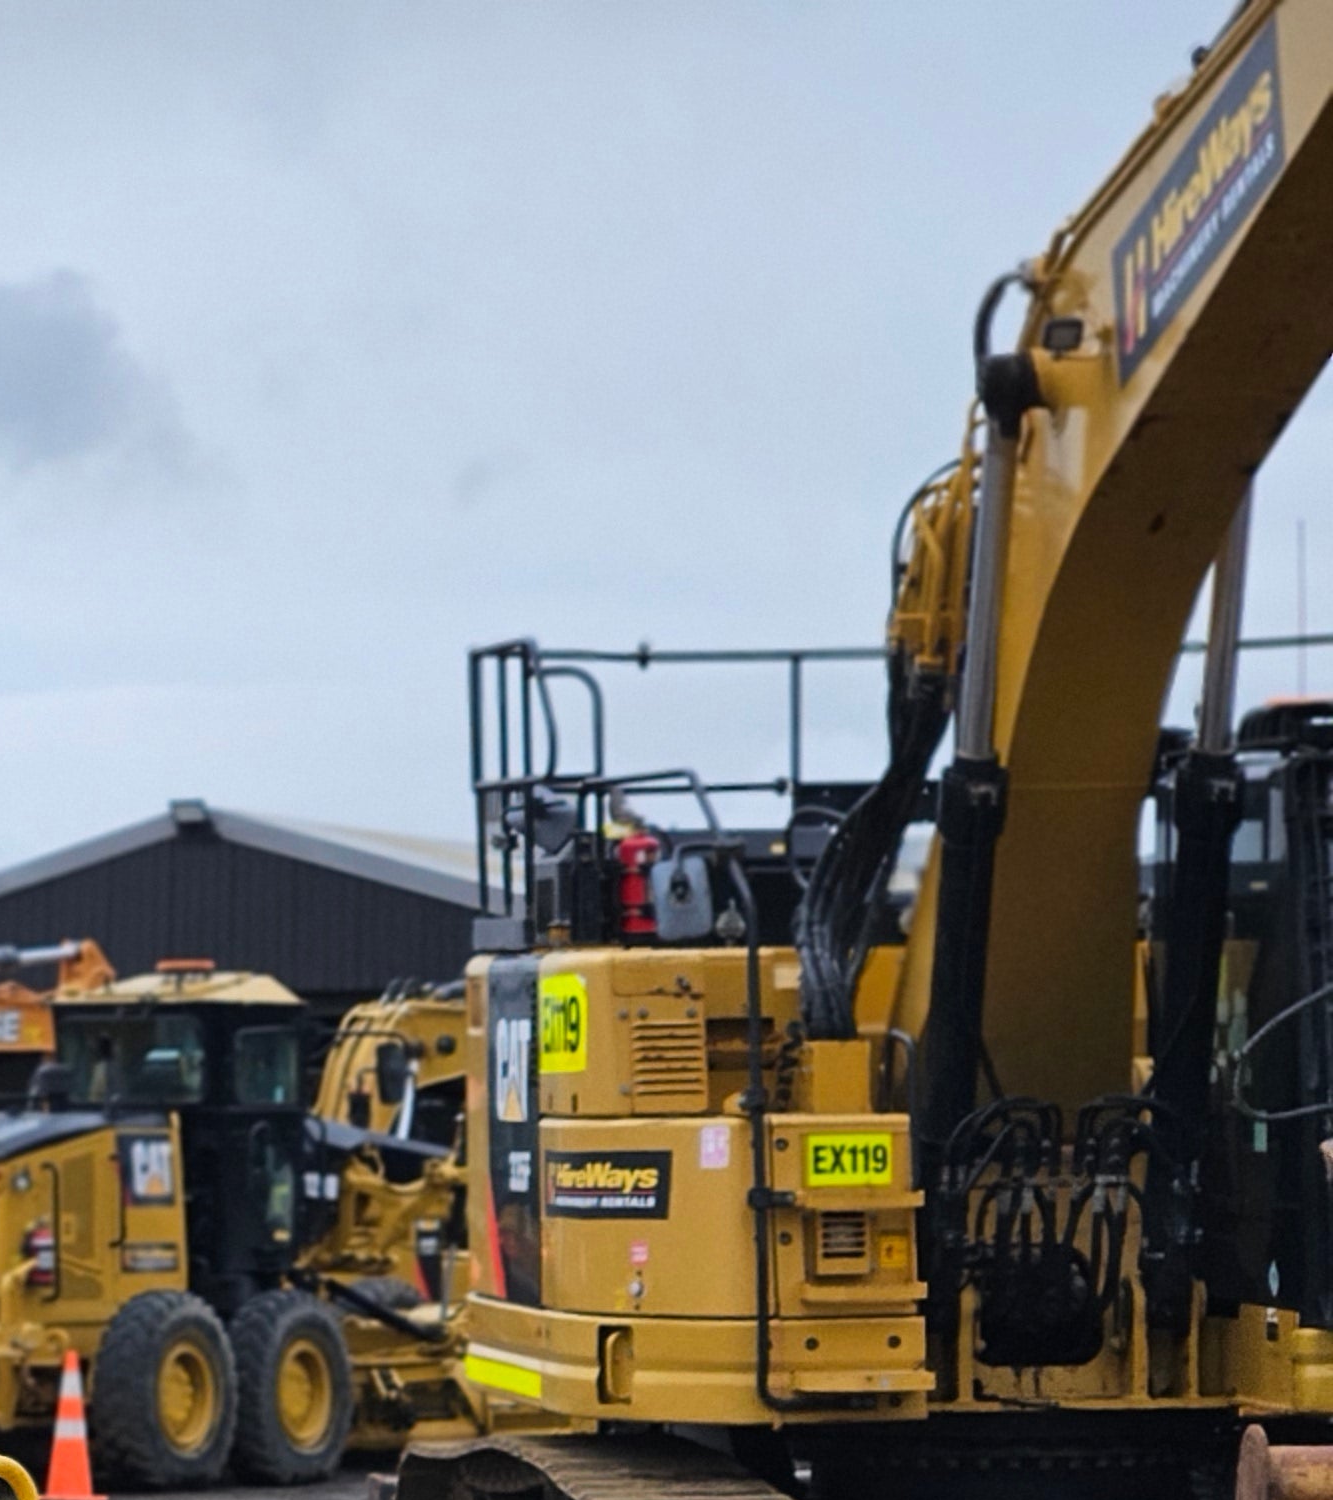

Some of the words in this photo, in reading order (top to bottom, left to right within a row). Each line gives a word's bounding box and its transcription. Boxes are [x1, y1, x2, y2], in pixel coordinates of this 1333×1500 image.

[496, 1018, 532, 1122] CAT
[130, 1140, 173, 1197] CAT
[812, 1144, 889, 1175] EX119
